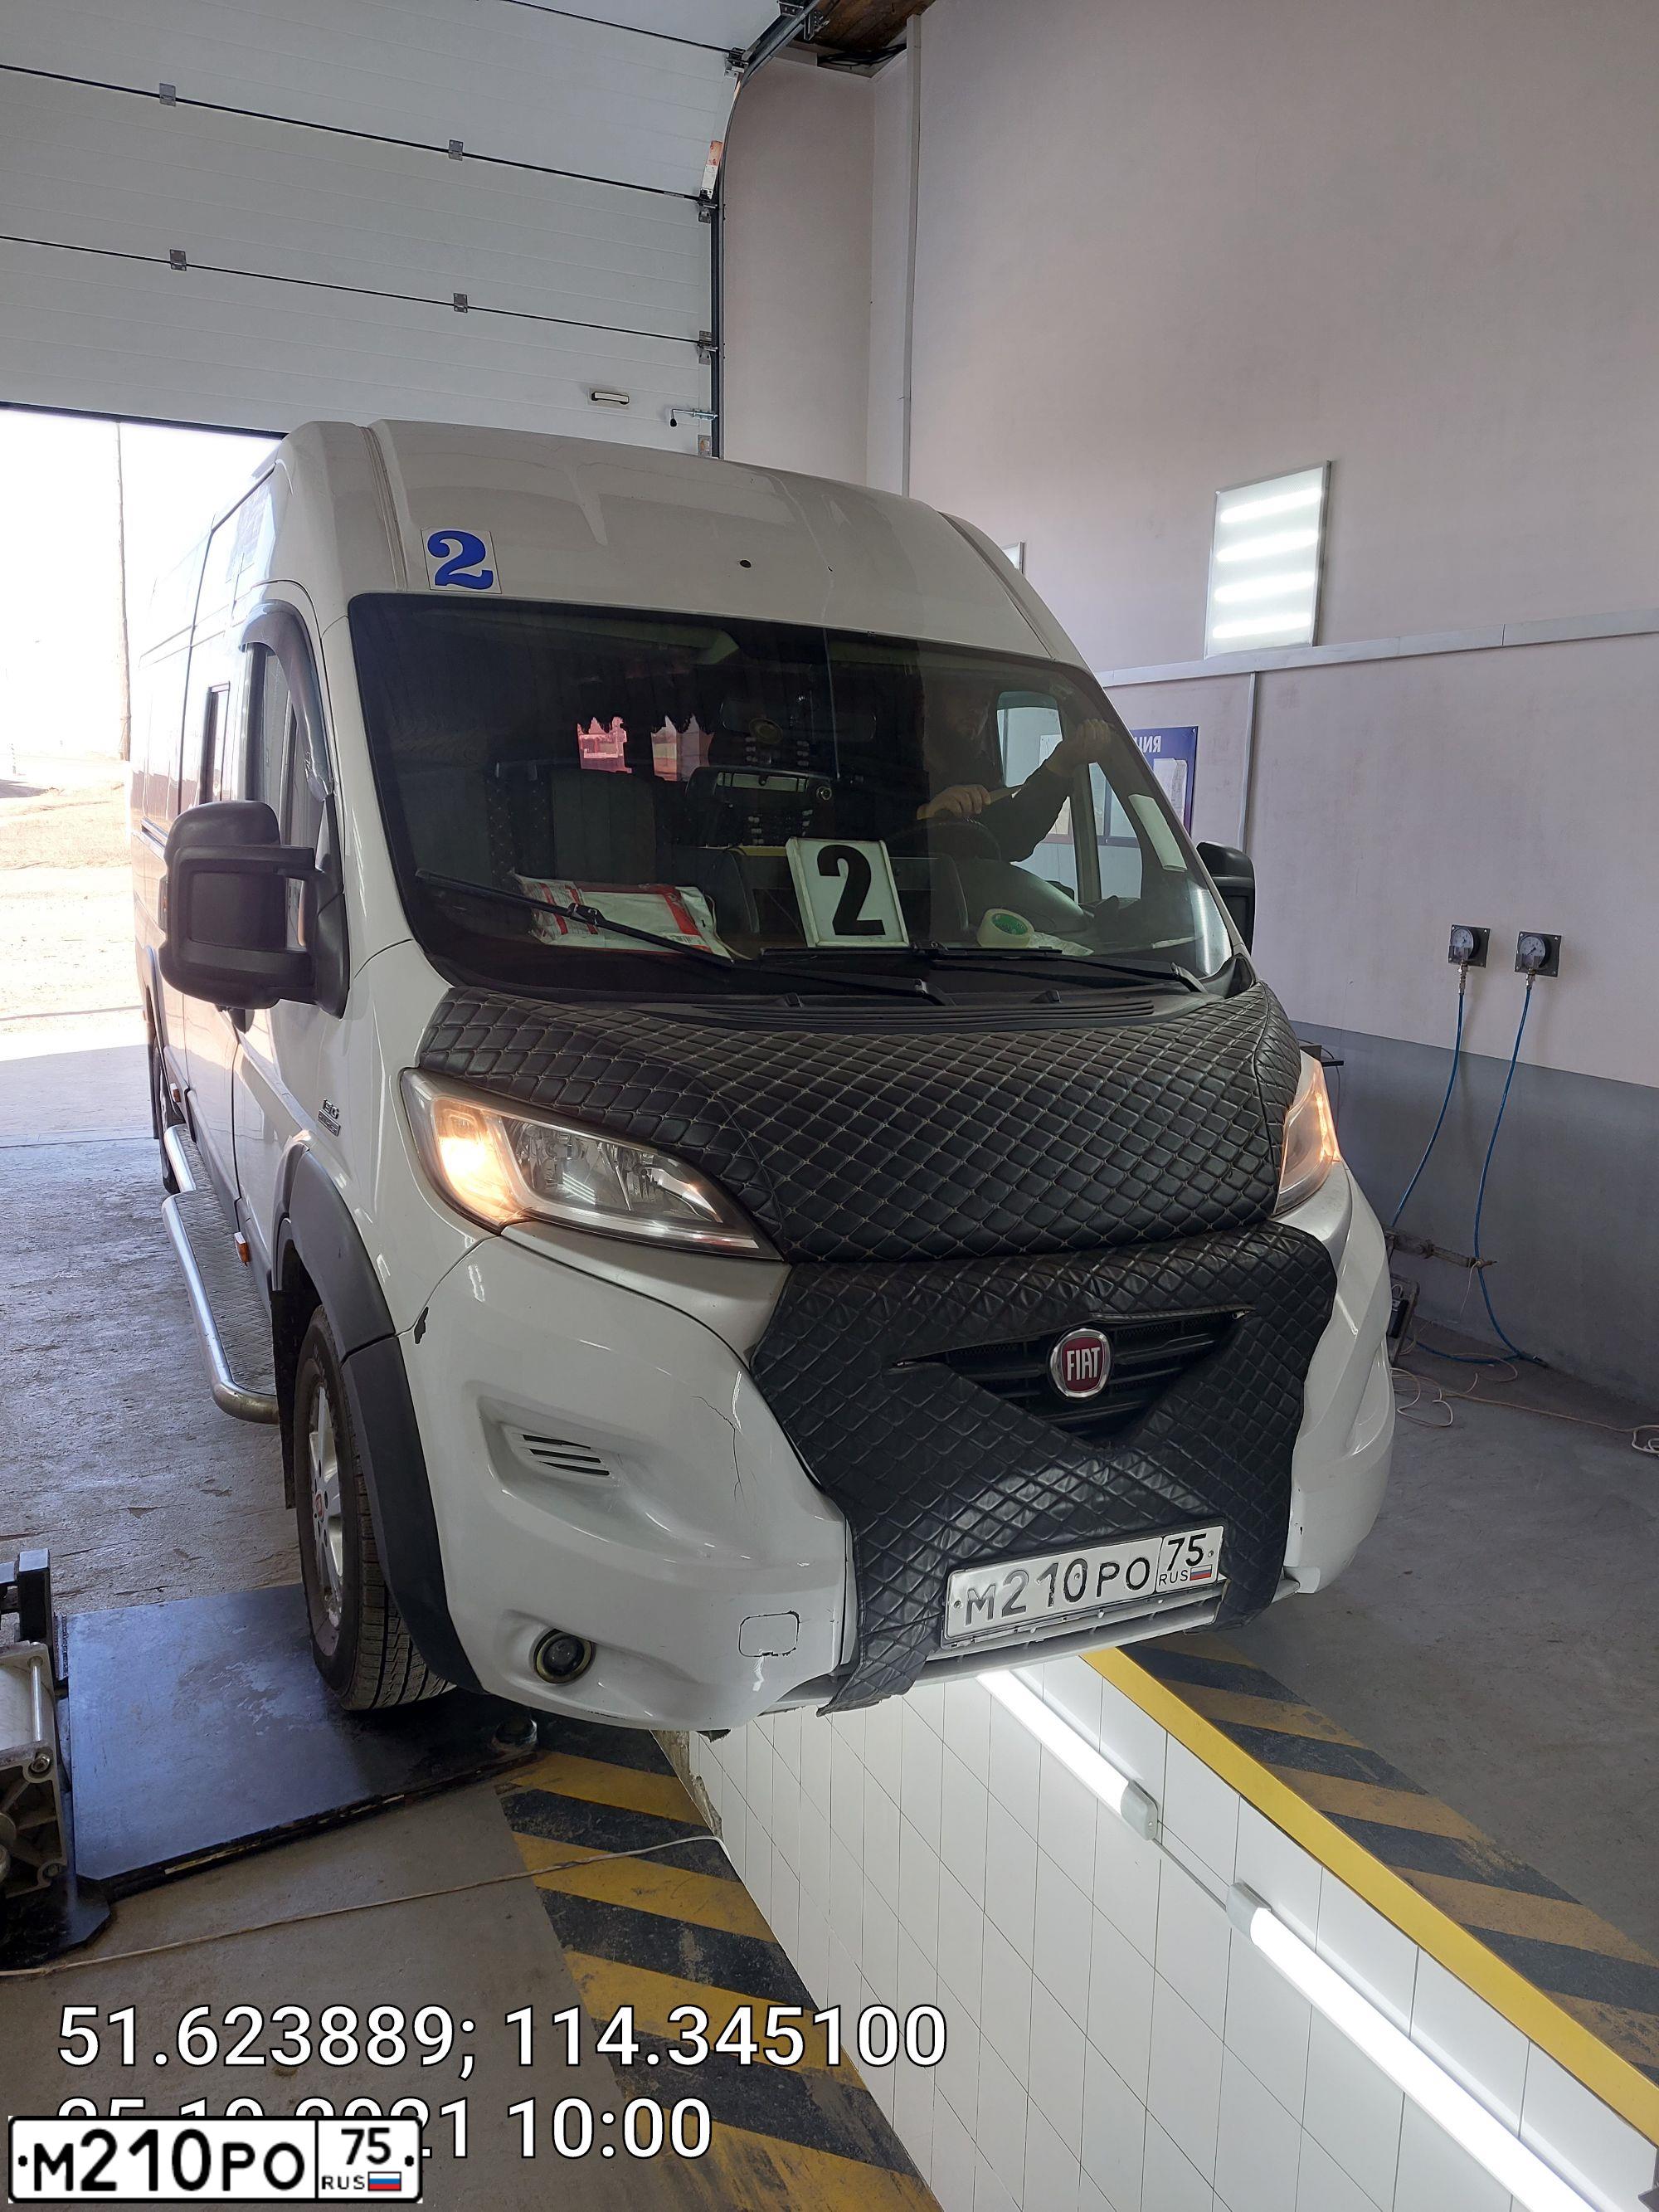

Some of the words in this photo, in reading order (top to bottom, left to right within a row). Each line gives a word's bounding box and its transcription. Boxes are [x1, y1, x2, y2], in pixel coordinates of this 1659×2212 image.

[427, 530, 494, 590] 2
[817, 845, 886, 935] 2
[1066, 1347, 1101, 1381] FIAT
[963, 1557, 1151, 1626] М210РО
[1165, 1533, 1207, 1572] 75
[1159, 1569, 1189, 1586] RUS
